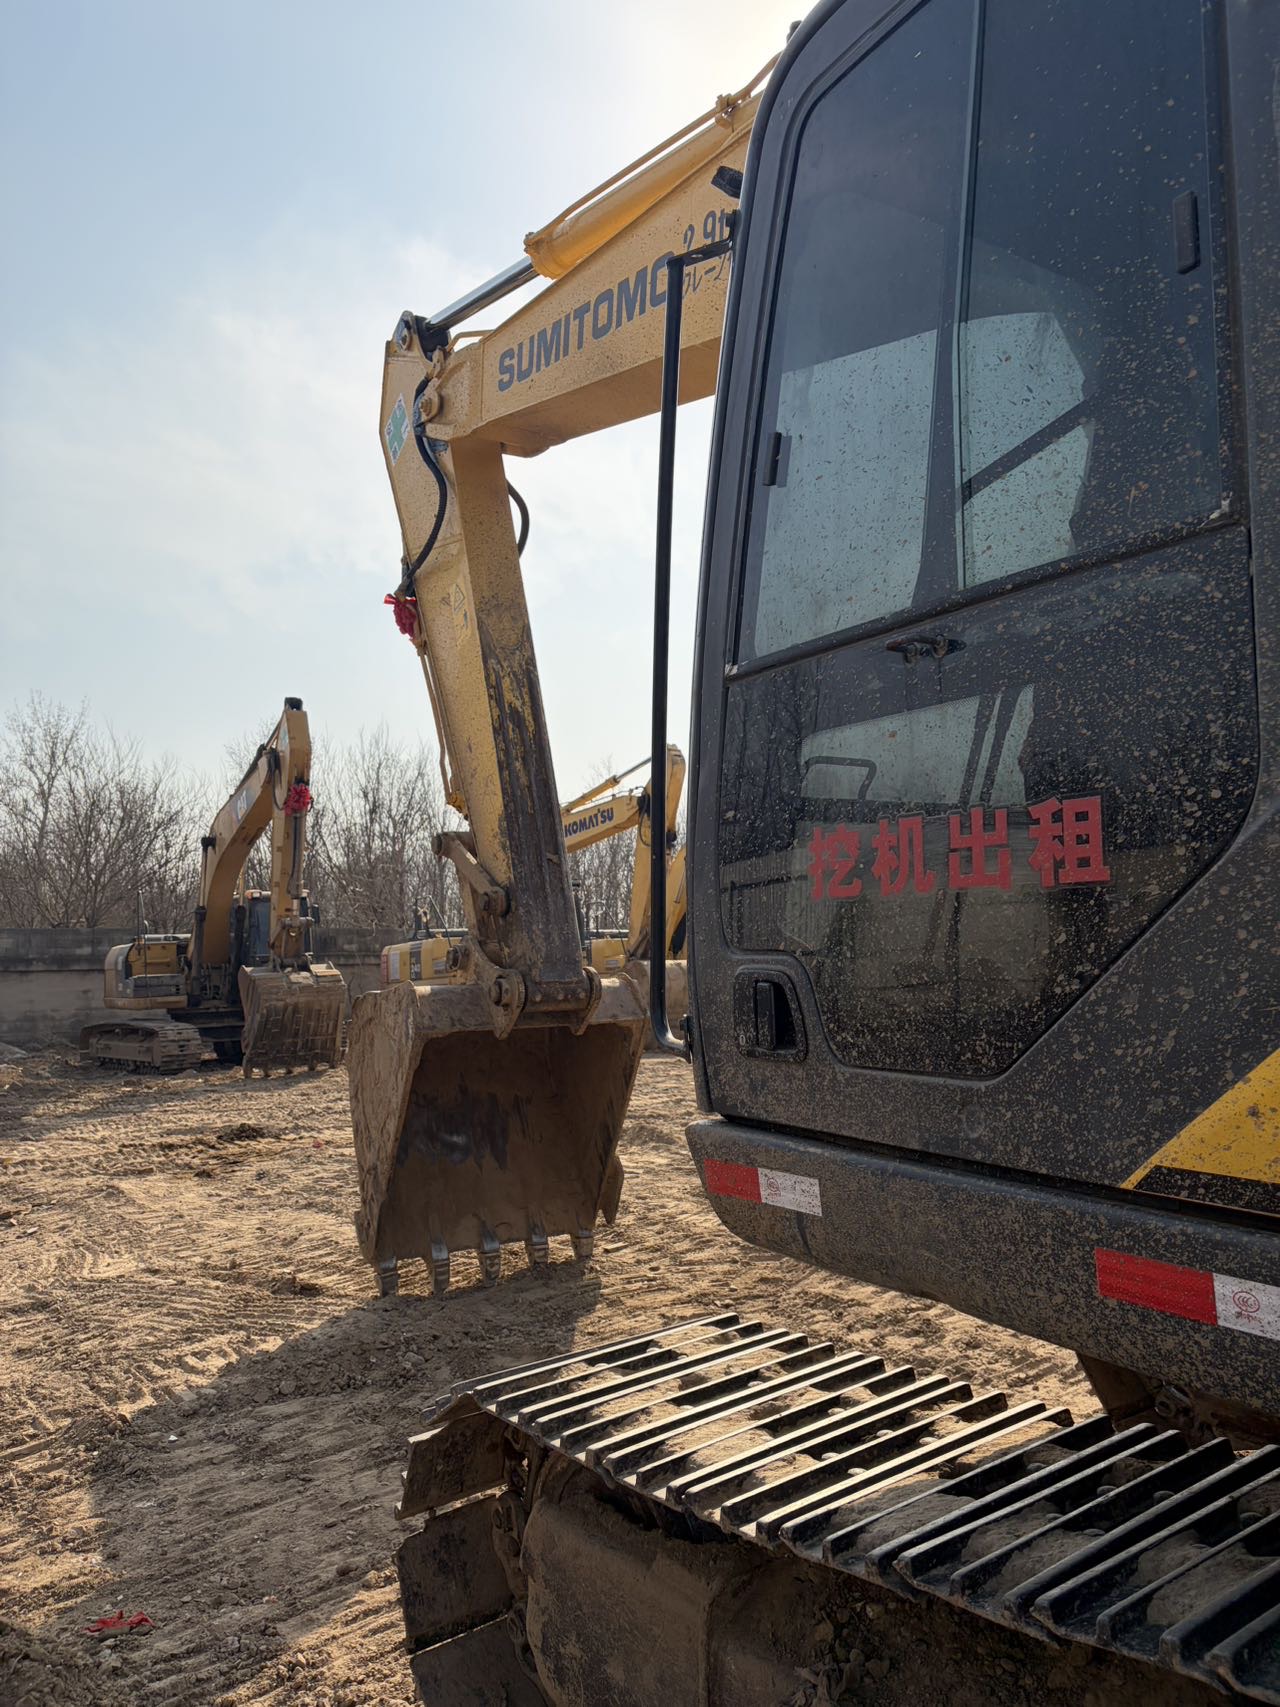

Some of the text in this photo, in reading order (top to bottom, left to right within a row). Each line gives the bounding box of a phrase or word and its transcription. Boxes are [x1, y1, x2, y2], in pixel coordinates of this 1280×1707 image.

[564, 807, 614, 837] KOMATSU
[808, 795, 1111, 900] 挖机出租
